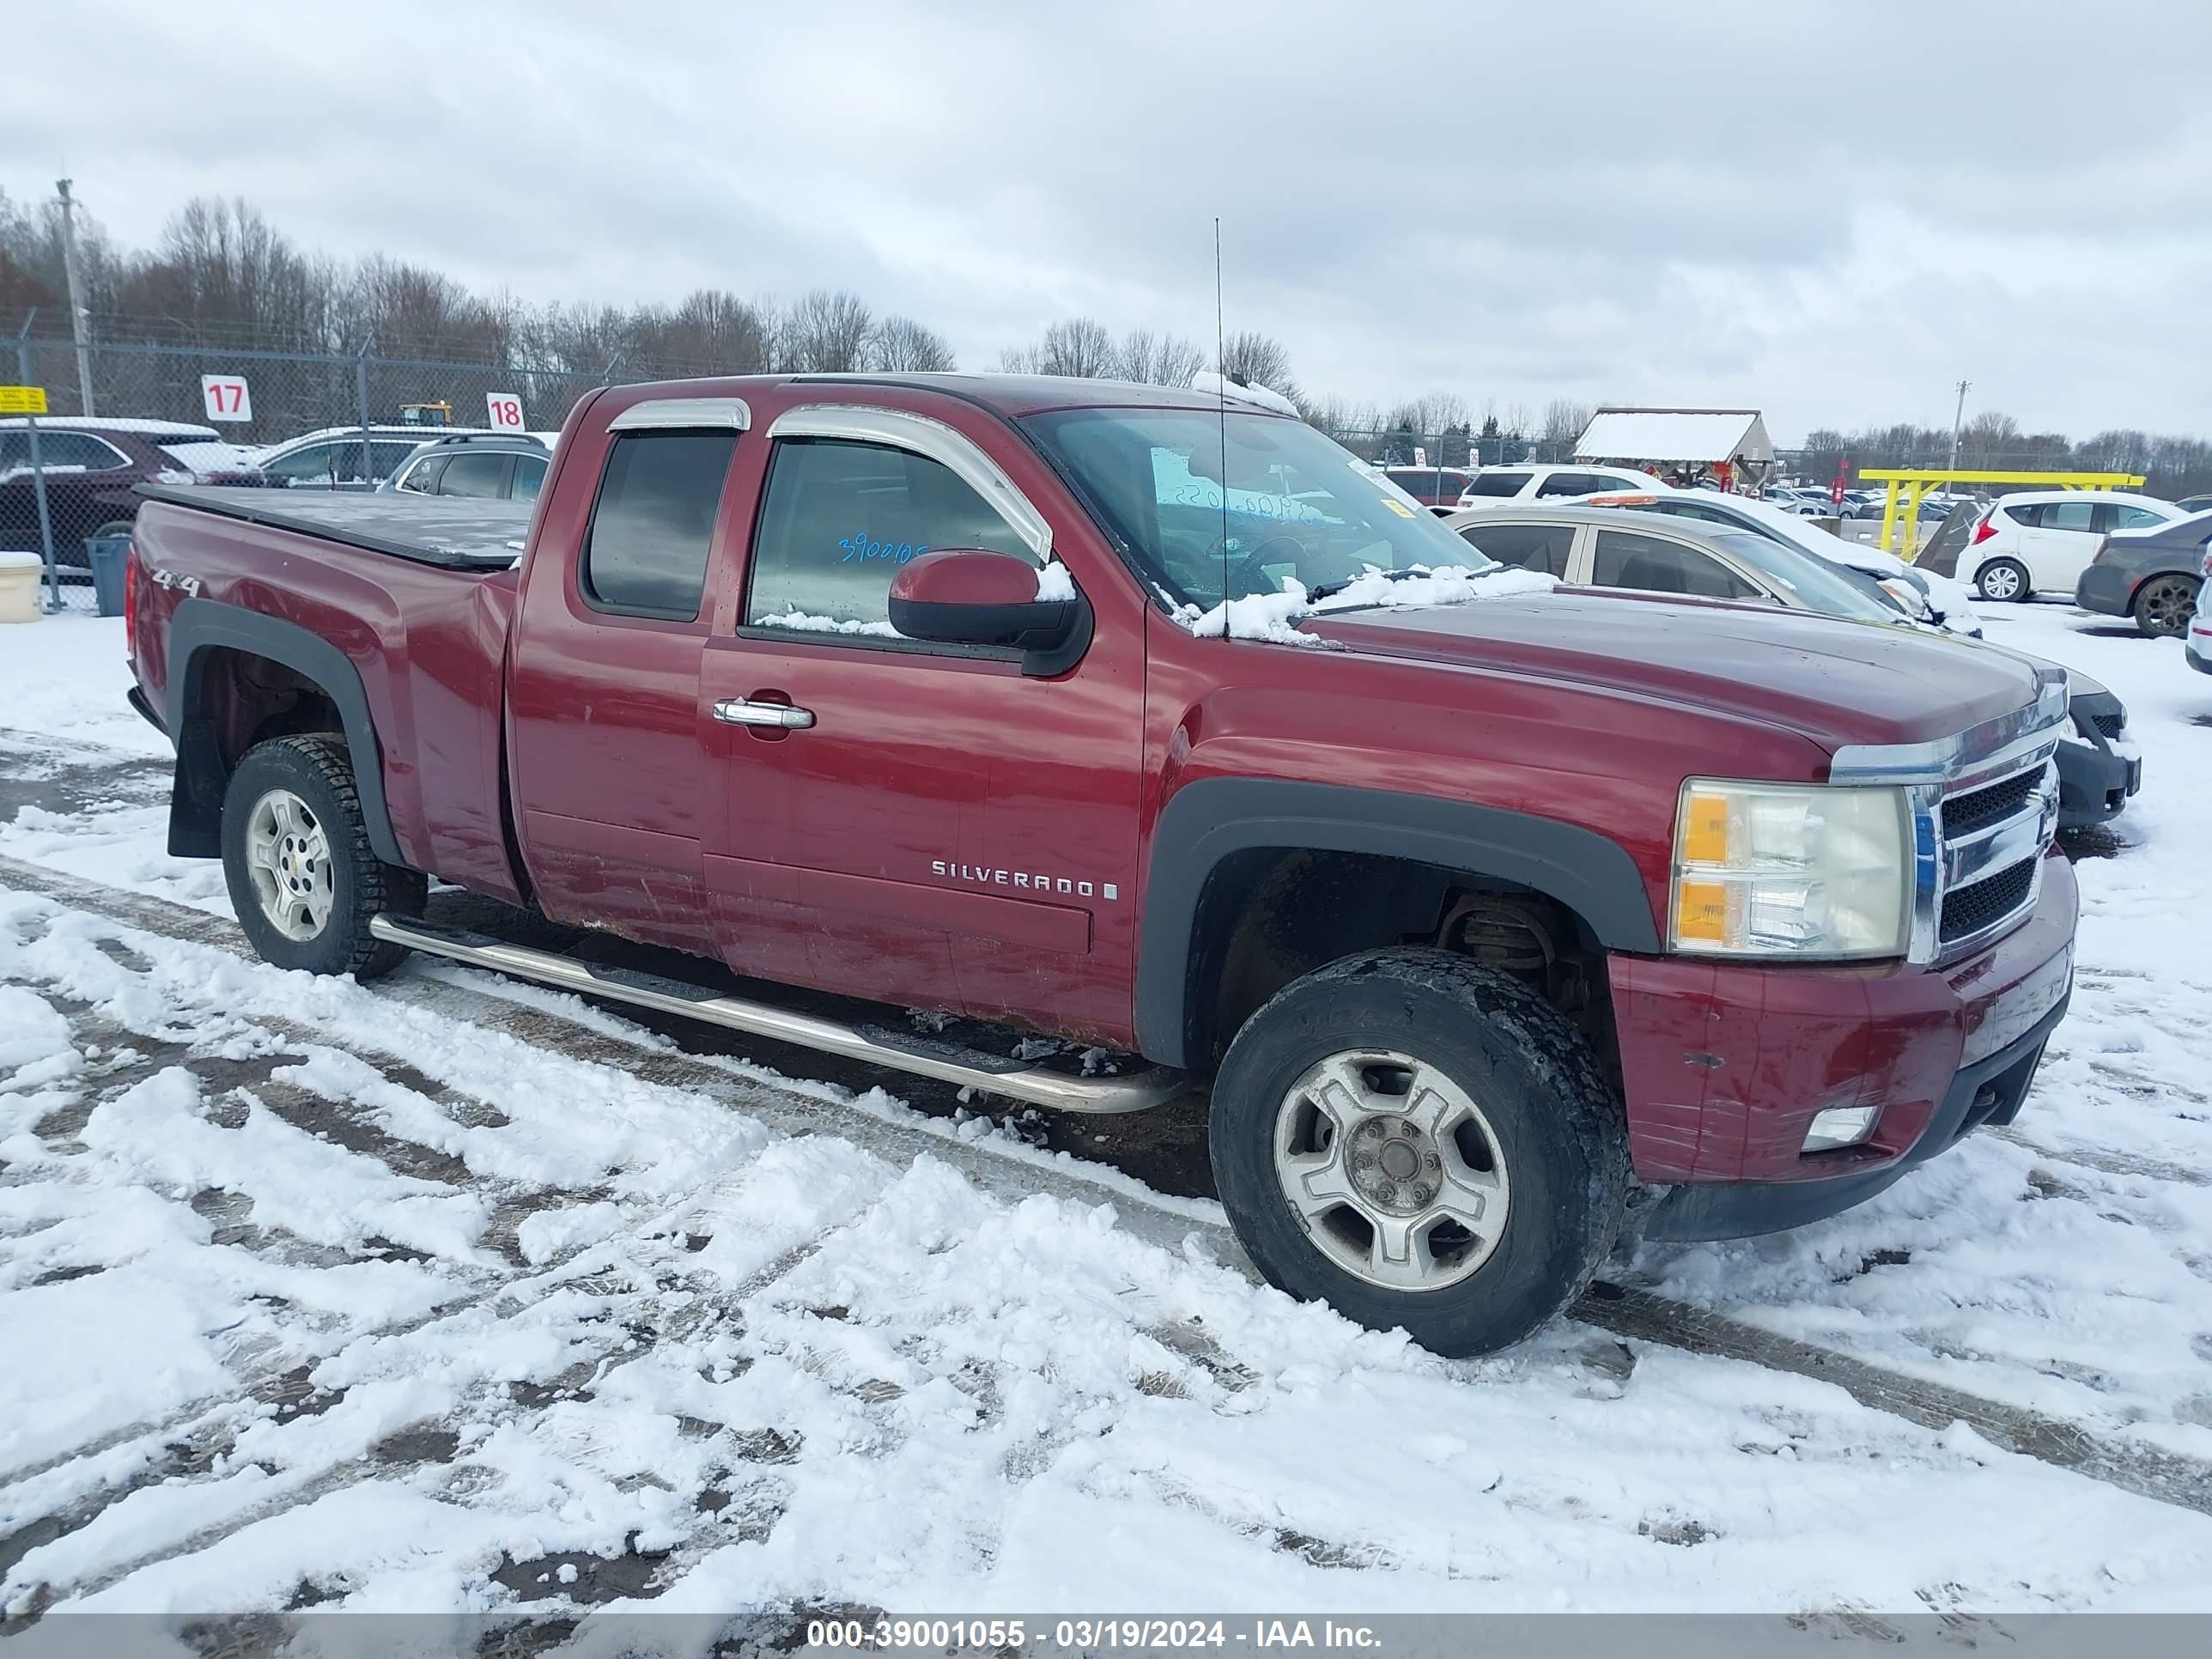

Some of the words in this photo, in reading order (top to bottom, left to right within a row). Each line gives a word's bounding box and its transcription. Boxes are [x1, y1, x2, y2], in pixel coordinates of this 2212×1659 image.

[209, 385, 242, 412] 17
[491, 401, 520, 426] 18
[1416, 452, 1425, 465] 25
[932, 860, 1094, 896] SILVERADO
